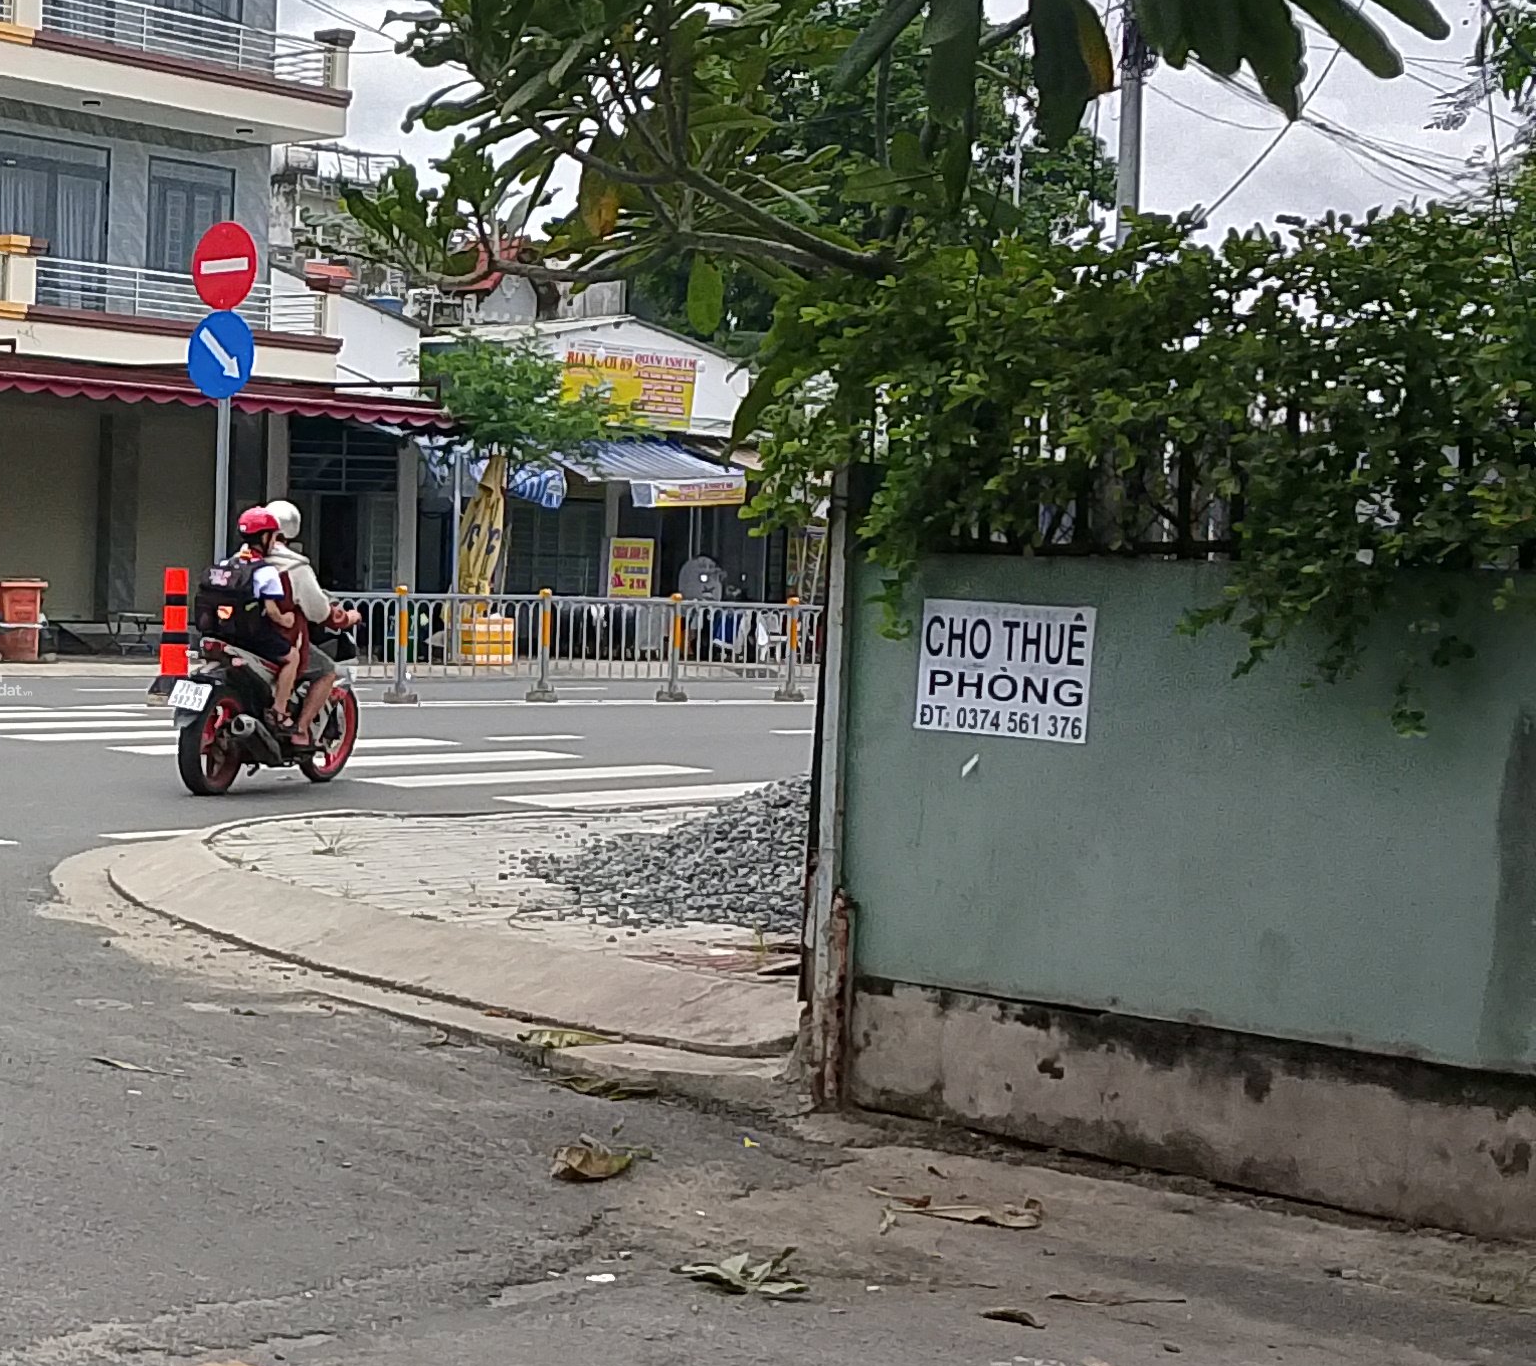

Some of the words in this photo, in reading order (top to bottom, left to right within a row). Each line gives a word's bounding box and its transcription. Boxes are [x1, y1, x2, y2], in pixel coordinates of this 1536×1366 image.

[925, 615, 992, 660] CHO
[1003, 613, 1087, 666] THUÊ
[928, 667, 1084, 707] PHÒNG
[920, 704, 951, 728] ĐT:
[956, 706, 1000, 731] 0374
[1007, 711, 1040, 734] 561
[1047, 715, 1082, 739] 376
